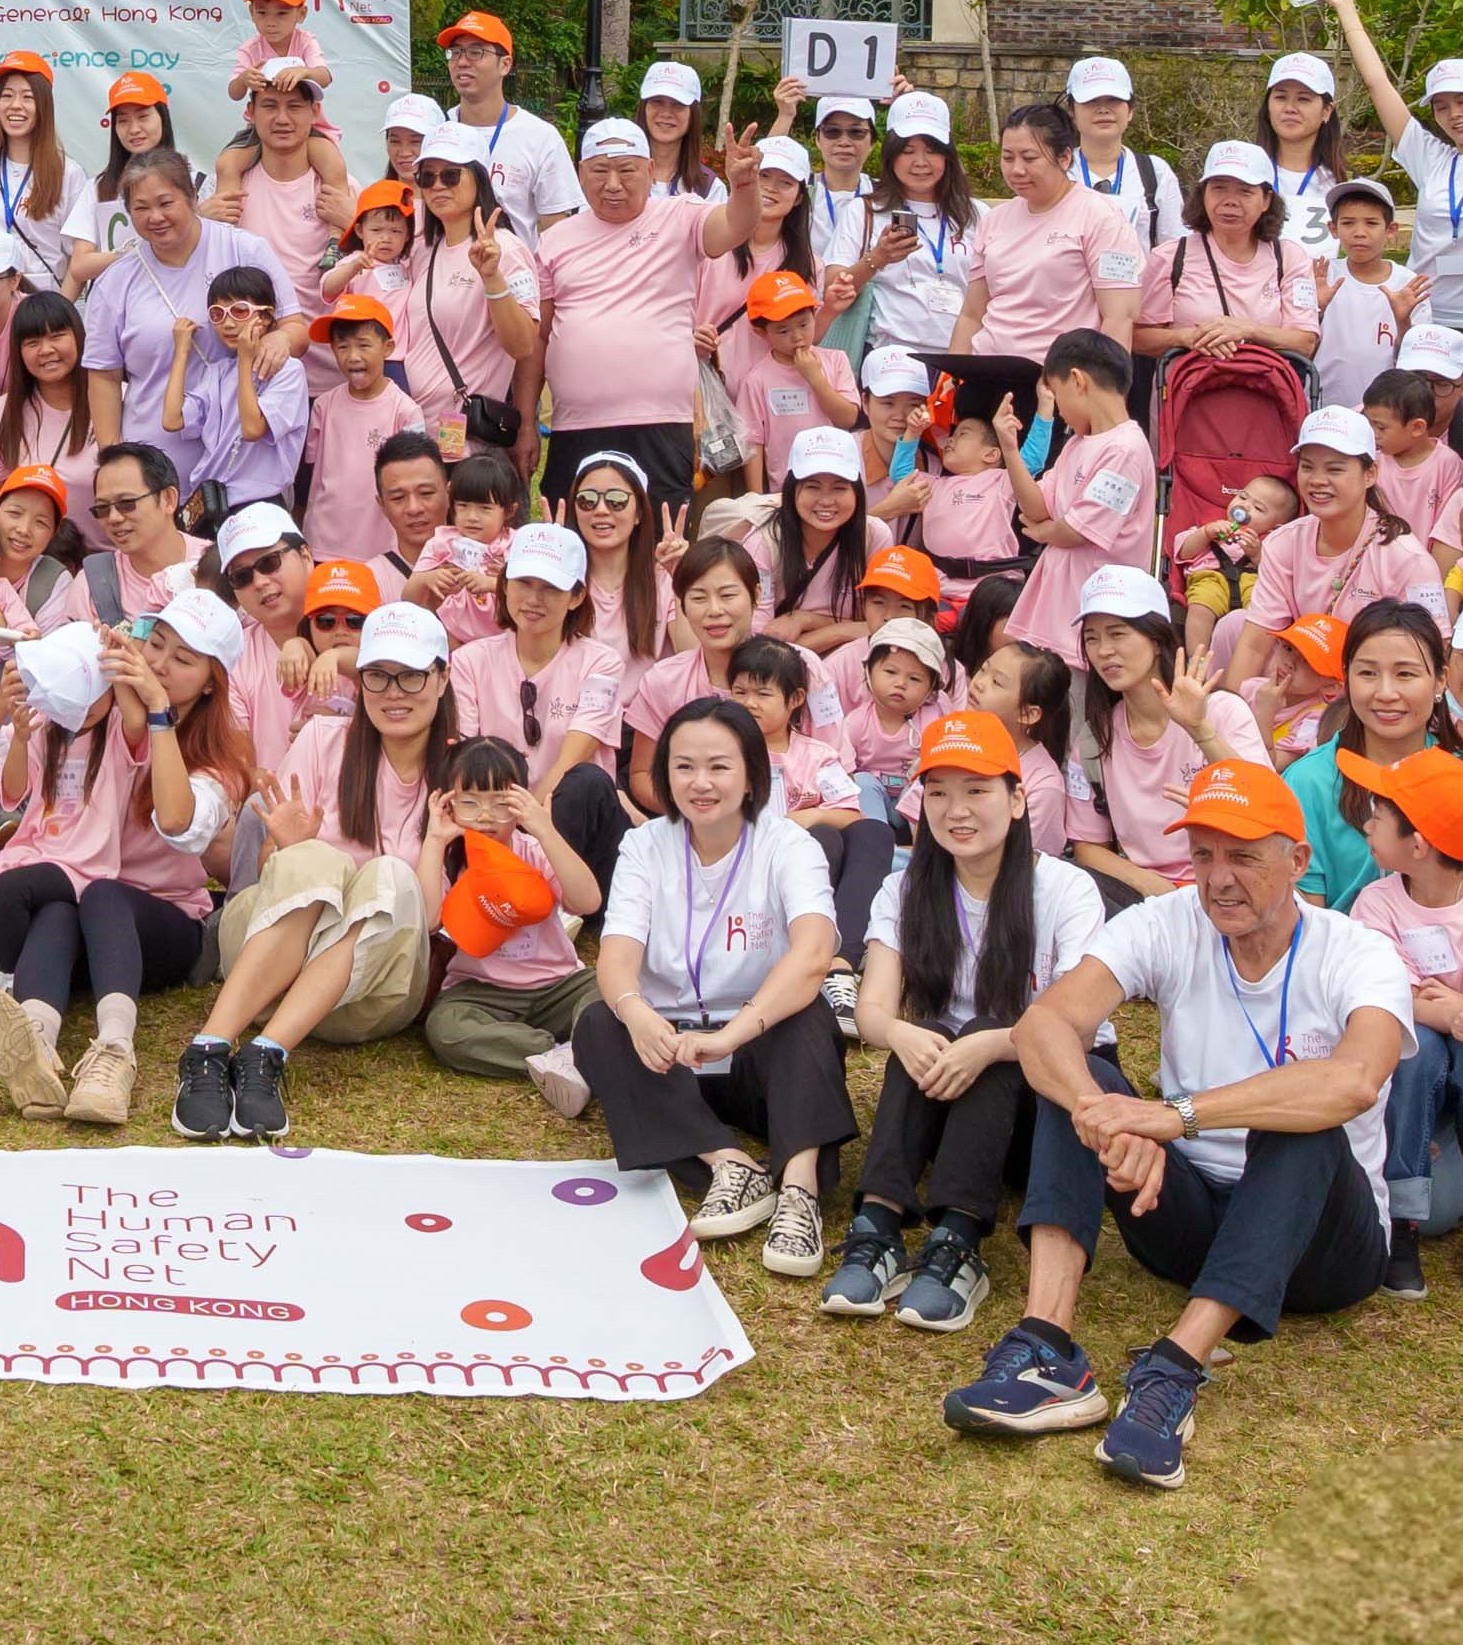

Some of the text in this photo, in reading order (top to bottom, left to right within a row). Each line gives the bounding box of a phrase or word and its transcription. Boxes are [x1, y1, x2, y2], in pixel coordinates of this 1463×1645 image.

[101, 5, 158, 24] Hong
[168, 4, 223, 23] Kong
[349, 2, 372, 13] Net
[130, 49, 181, 74] Day
[1301, 1033, 1322, 1043] The
[1302, 1045, 1333, 1055] Hum
[61, 1183, 179, 1209] The
[68, 1207, 297, 1233] Human
[65, 1231, 278, 1269] Safety
[68, 1256, 188, 1287] Net
[70, 1293, 291, 1320] HONG KONG
